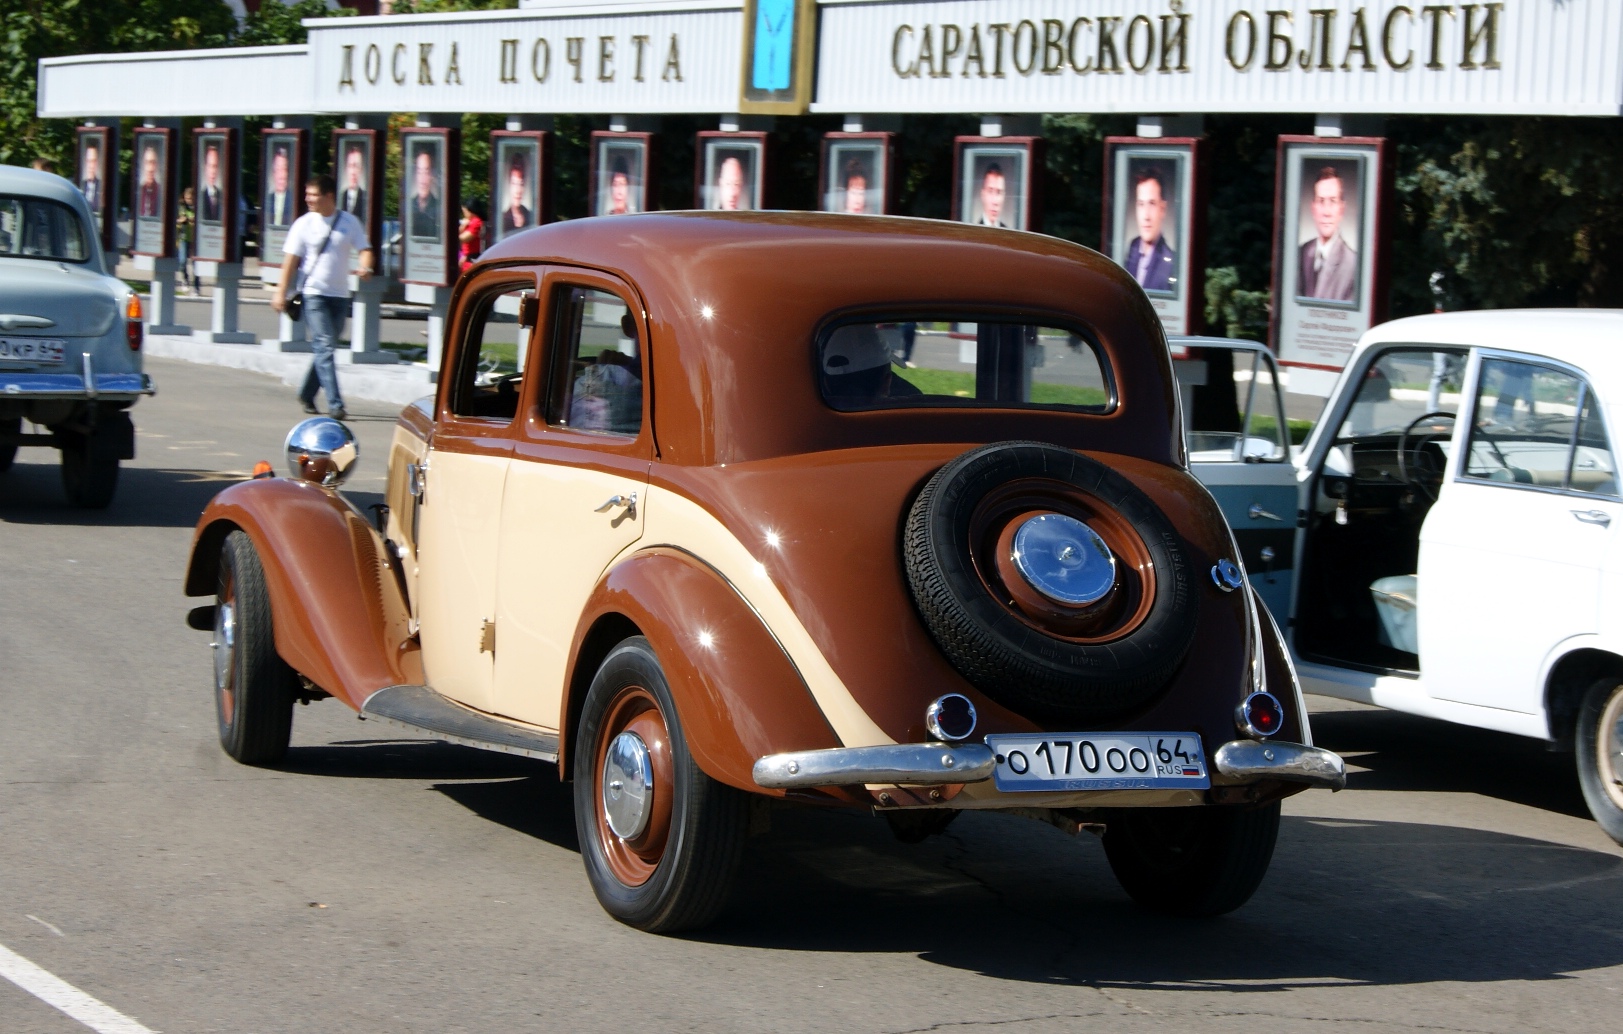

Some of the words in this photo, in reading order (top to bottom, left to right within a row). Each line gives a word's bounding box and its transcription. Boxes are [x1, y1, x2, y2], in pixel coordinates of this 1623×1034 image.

[891, 0, 1193, 79] САРАТОВСКОЙ
[1225, 2, 1504, 73] ОБЛАСТИ
[339, 41, 463, 93] ДОСКА
[499, 33, 684, 84] ПОЧЕТА
[1156, 739, 1190, 764] 64
[1158, 765, 1182, 775] RUS
